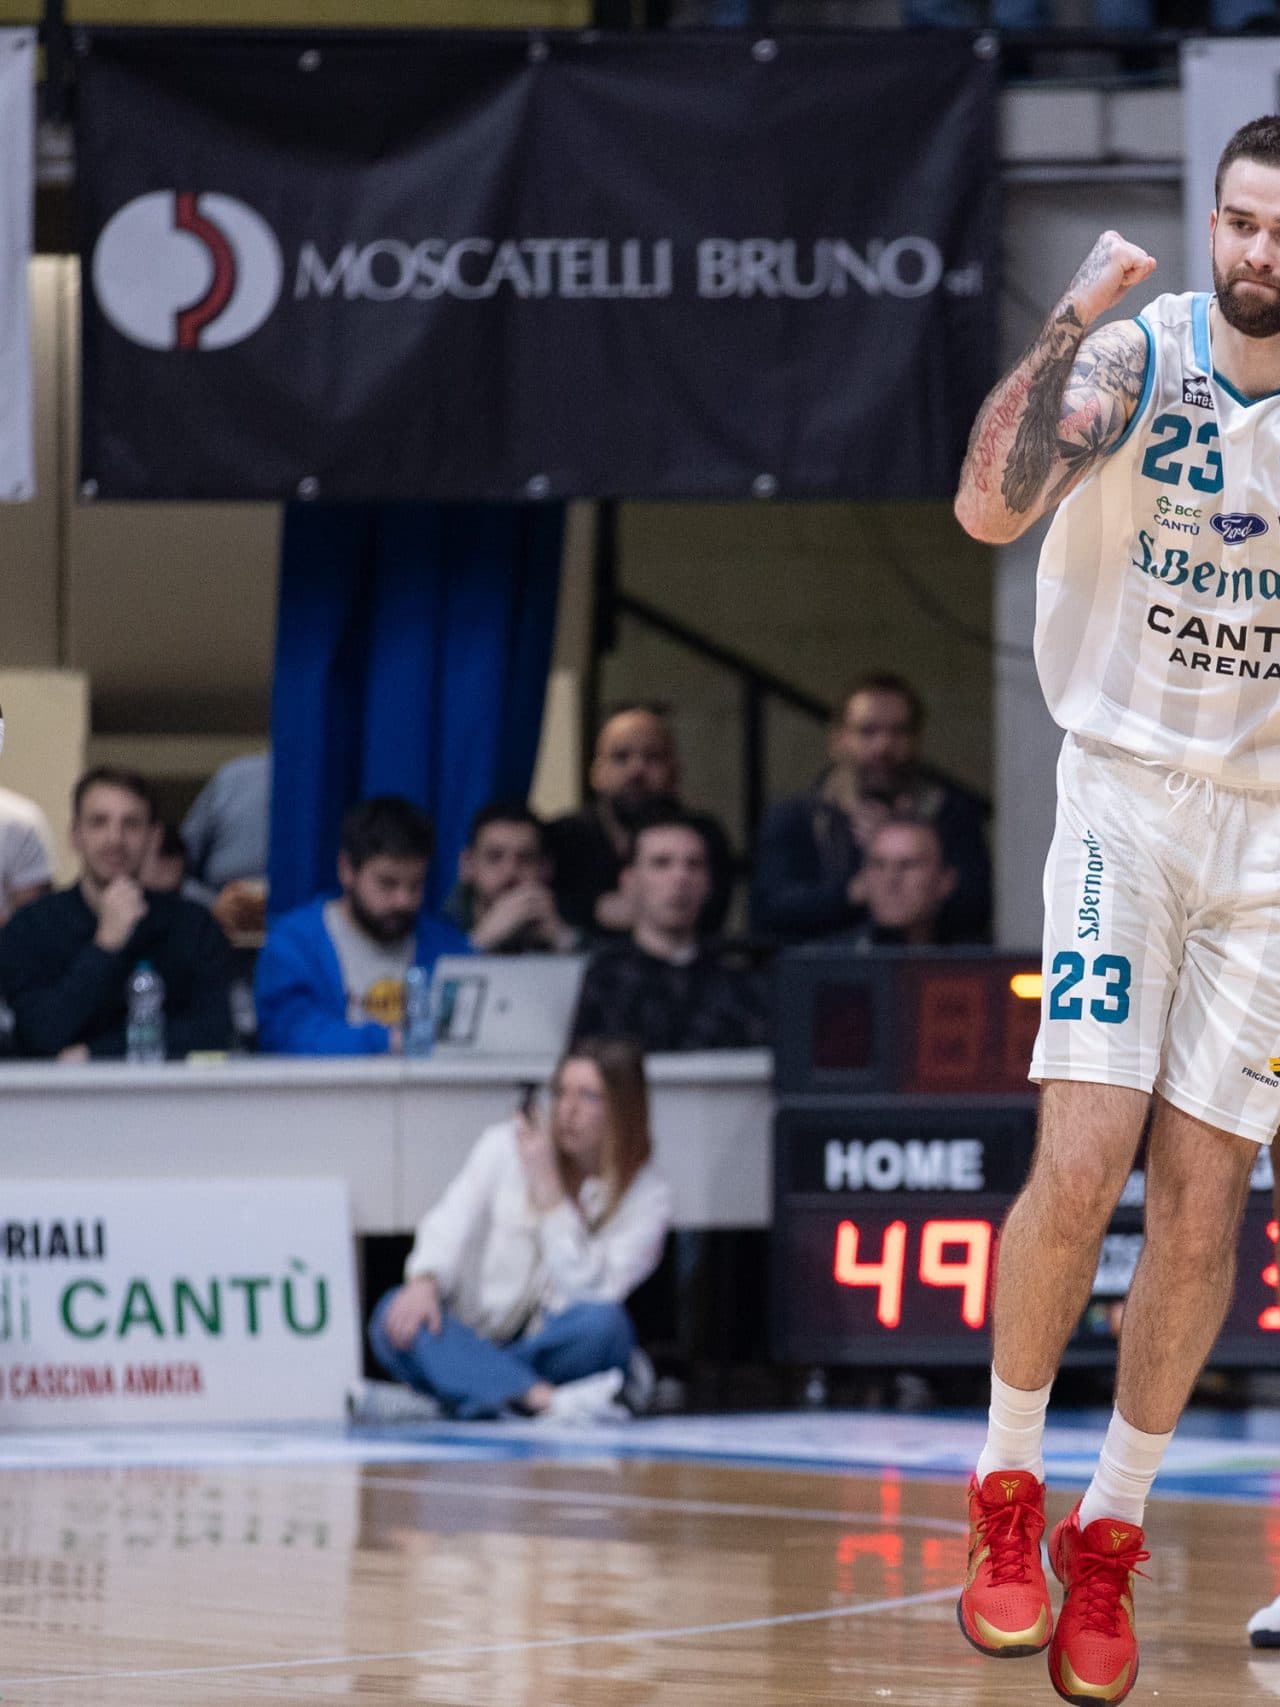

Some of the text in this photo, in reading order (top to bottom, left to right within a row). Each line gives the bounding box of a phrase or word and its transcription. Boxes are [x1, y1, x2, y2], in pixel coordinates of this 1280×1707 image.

[295, 236, 673, 300] MOSCATELLI
[697, 235, 943, 300] BRUNO
[1141, 413, 1224, 494] 23
[1153, 513, 1201, 536] CANTÙ
[1175, 504, 1203, 519] BCC
[1049, 951, 1131, 1025] 23
[1242, 1066, 1279, 1089] FRIGERIO
[825, 1138, 985, 1191] HOME
[0, 1220, 105, 1259] RIALI
[60, 1256, 329, 1340] CANTÙ
[833, 1218, 994, 1330] 49
[9, 1363, 203, 1397] CASCINA AMATA
